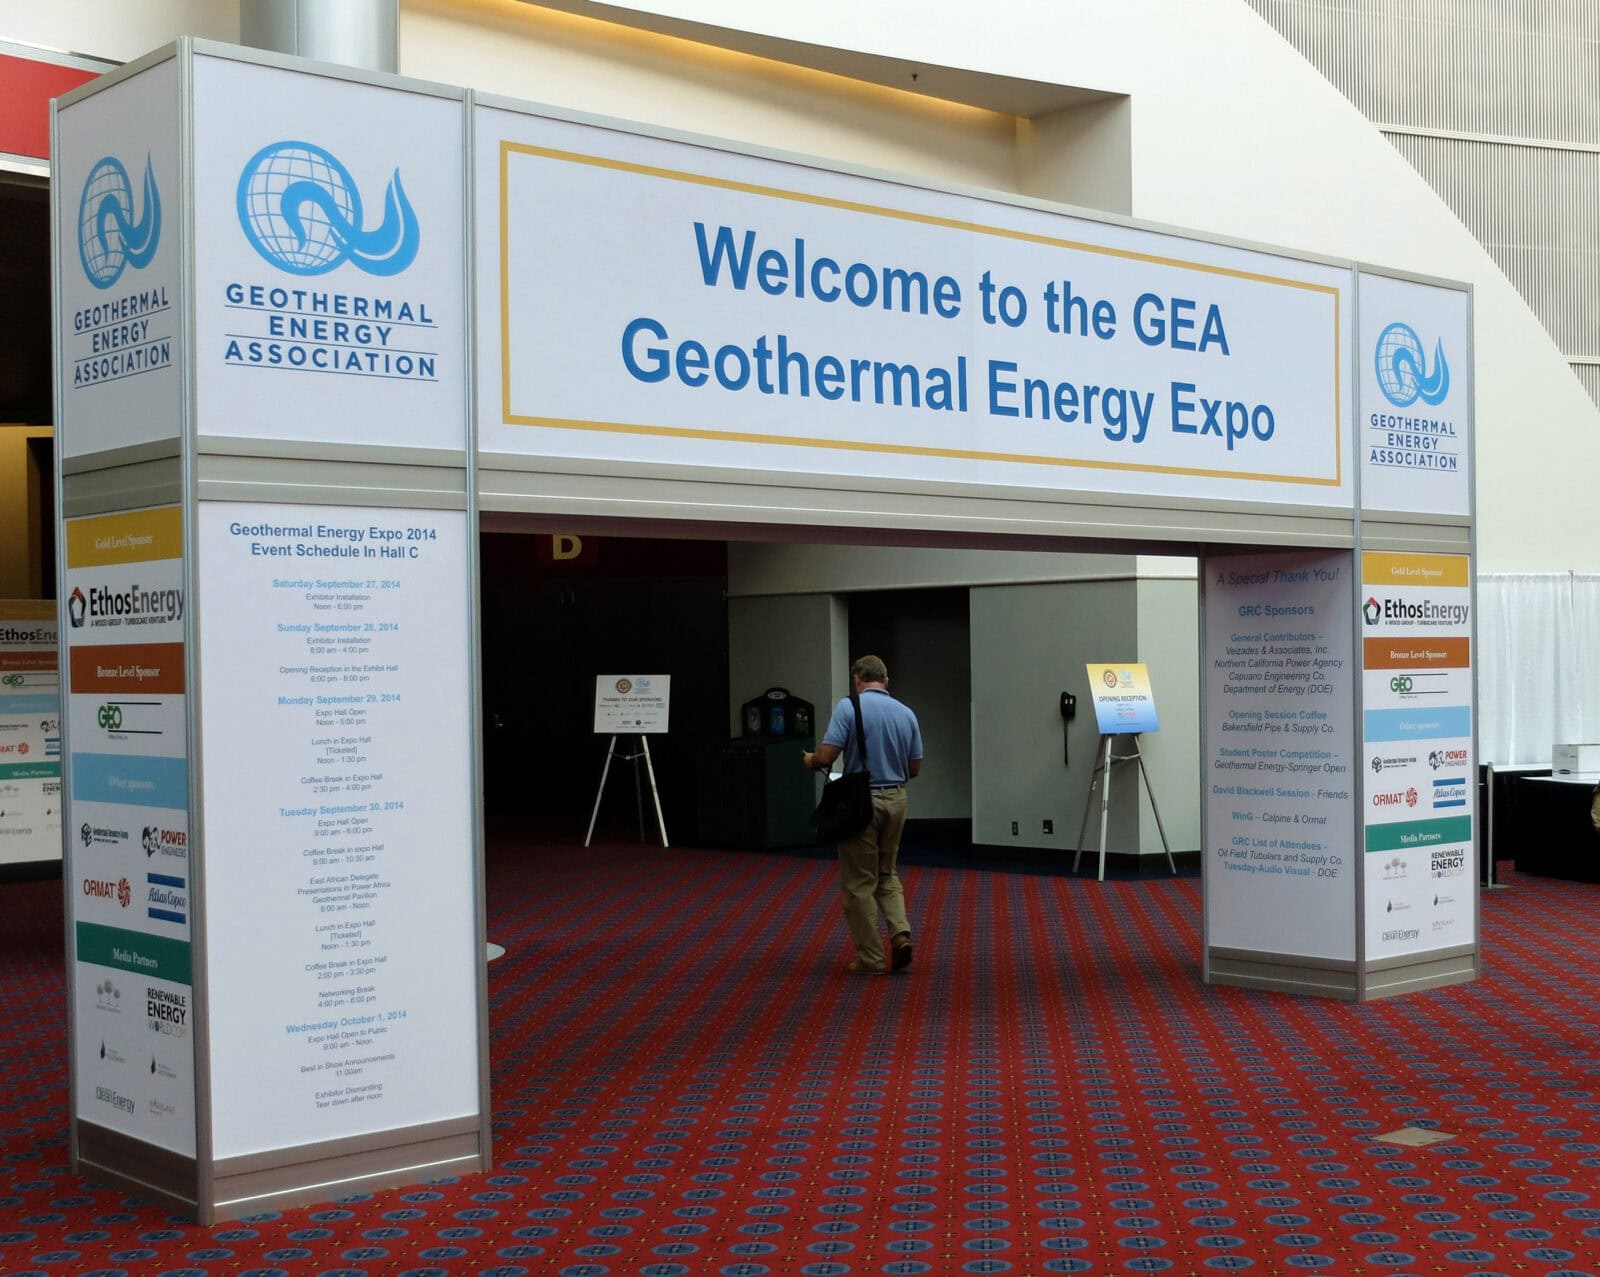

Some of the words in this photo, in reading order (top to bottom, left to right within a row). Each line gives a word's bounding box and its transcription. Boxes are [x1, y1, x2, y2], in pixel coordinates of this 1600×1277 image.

[694, 221, 961, 318] Welcome
[979, 270, 1026, 328] to
[1044, 281, 1116, 340] the
[1133, 292, 1230, 356] GEA
[74, 286, 168, 331] GEOTHERMAL
[226, 283, 432, 323] GEOTHERMAL
[93, 320, 148, 353] ENERGY
[270, 316, 391, 345] ENERGY
[74, 342, 170, 384] ASSOCIATION
[225, 340, 434, 376] ASSOCIATION
[622, 318, 966, 412] Geothermal
[988, 360, 1154, 444] Energy
[1170, 382, 1274, 450] Expo
[1371, 414, 1455, 434] GEOTHERMAL
[1388, 434, 1438, 450] ENERGY
[1370, 450, 1456, 468] ASSOCIATION
[230, 523, 312, 537] Geothermal
[317, 526, 364, 541] Energy
[370, 527, 402, 542] Expo
[407, 528, 436, 540] 2014
[251, 543, 292, 556] Event
[296, 544, 359, 557] Schedule
[365, 546, 375, 557] In
[380, 546, 404, 558] Hall
[409, 547, 418, 558] C
[553, 534, 582, 560] D
[273, 579, 313, 590] Saturday
[316, 580, 363, 590] September
[1228, 572, 1270, 587] Special
[1274, 568, 1309, 582] Thank
[1313, 567, 1339, 581] You!
[90, 585, 184, 620] EthosEnergy
[1239, 606, 1261, 616] GRC
[1264, 606, 1314, 618] Sponsors
[1385, 599, 1468, 624] EthosEnergy
[277, 623, 311, 633] Sunday
[314, 624, 361, 633] September
[379, 623, 399, 631] 2014
[1232, 634, 1261, 642] General
[1264, 633, 1316, 642] Contributors
[1390, 650, 1408, 658] Bronze
[1411, 650, 1424, 658] Level
[1426, 650, 1446, 660] Sponsor
[1215, 660, 1246, 668] Northern
[1248, 659, 1283, 668] California
[1286, 659, 1310, 667] Power
[1312, 659, 1343, 669] Agency
[97, 666, 118, 678] Bronze
[119, 666, 135, 677] Level
[136, 666, 160, 680] Sponsor
[1264, 672, 1310, 682] Engineering
[1224, 684, 1266, 694] Department
[1278, 685, 1304, 696] Energy
[1308, 684, 1333, 695] (DOE)
[1390, 677, 1412, 692] GEO
[278, 696, 313, 706] Monday
[317, 695, 363, 705] September
[381, 694, 400, 702] 2014
[98, 706, 122, 729] GEO
[1229, 710, 1262, 720] Opening
[1264, 711, 1296, 719] Session
[1300, 711, 1327, 720] Coffee
[1222, 724, 1262, 732] Bakersfield
[1265, 724, 1281, 733] Pipe
[1292, 724, 1318, 734] Supply
[1322, 724, 1335, 732] Co.
[1220, 748, 1249, 756] Student
[1252, 749, 1276, 757] Poster
[1280, 750, 1330, 759] Competition
[1445, 750, 1466, 760] POWER
[1214, 760, 1256, 770] Geothermal
[1258, 761, 1320, 773] Energy-Springer
[1324, 762, 1346, 774] Open
[1214, 786, 1234, 794] David
[1236, 787, 1274, 796] Blackwell
[1276, 788, 1310, 797] Session
[1317, 789, 1348, 799] Friends
[1373, 793, 1402, 806] ORMAT
[280, 808, 316, 818] Tuesday
[320, 805, 366, 816] September
[385, 802, 404, 811] 2014
[1232, 812, 1252, 820] WinG
[1262, 813, 1290, 823] Calpine
[1302, 816, 1326, 824] Ormat
[161, 829, 186, 846] POWER
[1232, 837, 1250, 846] GRC
[1252, 838, 1266, 846] List
[1280, 840, 1320, 850] Attendees
[1400, 834, 1418, 843] Media
[1419, 833, 1440, 841] Partners
[1230, 849, 1247, 858] Field
[1250, 851, 1281, 860] Tubulars
[1283, 853, 1298, 862] and
[1300, 854, 1327, 865] Supply
[1330, 856, 1344, 864] Co.
[1432, 849, 1464, 859] RENEWABLE
[1224, 862, 1282, 874] Tuesday-Audio
[1285, 866, 1310, 876] Visual
[1318, 868, 1337, 878] DOE
[1432, 857, 1464, 870] ENERGY
[84, 878, 115, 899] ORMAT
[113, 948, 132, 962] Media
[133, 952, 158, 968] Partners
[148, 988, 186, 1007] RENEWABLE
[148, 1001, 186, 1024] ENERGY
[286, 1020, 338, 1034] Wednesday
[340, 1014, 375, 1026] October
[388, 1010, 407, 1020] 2014
